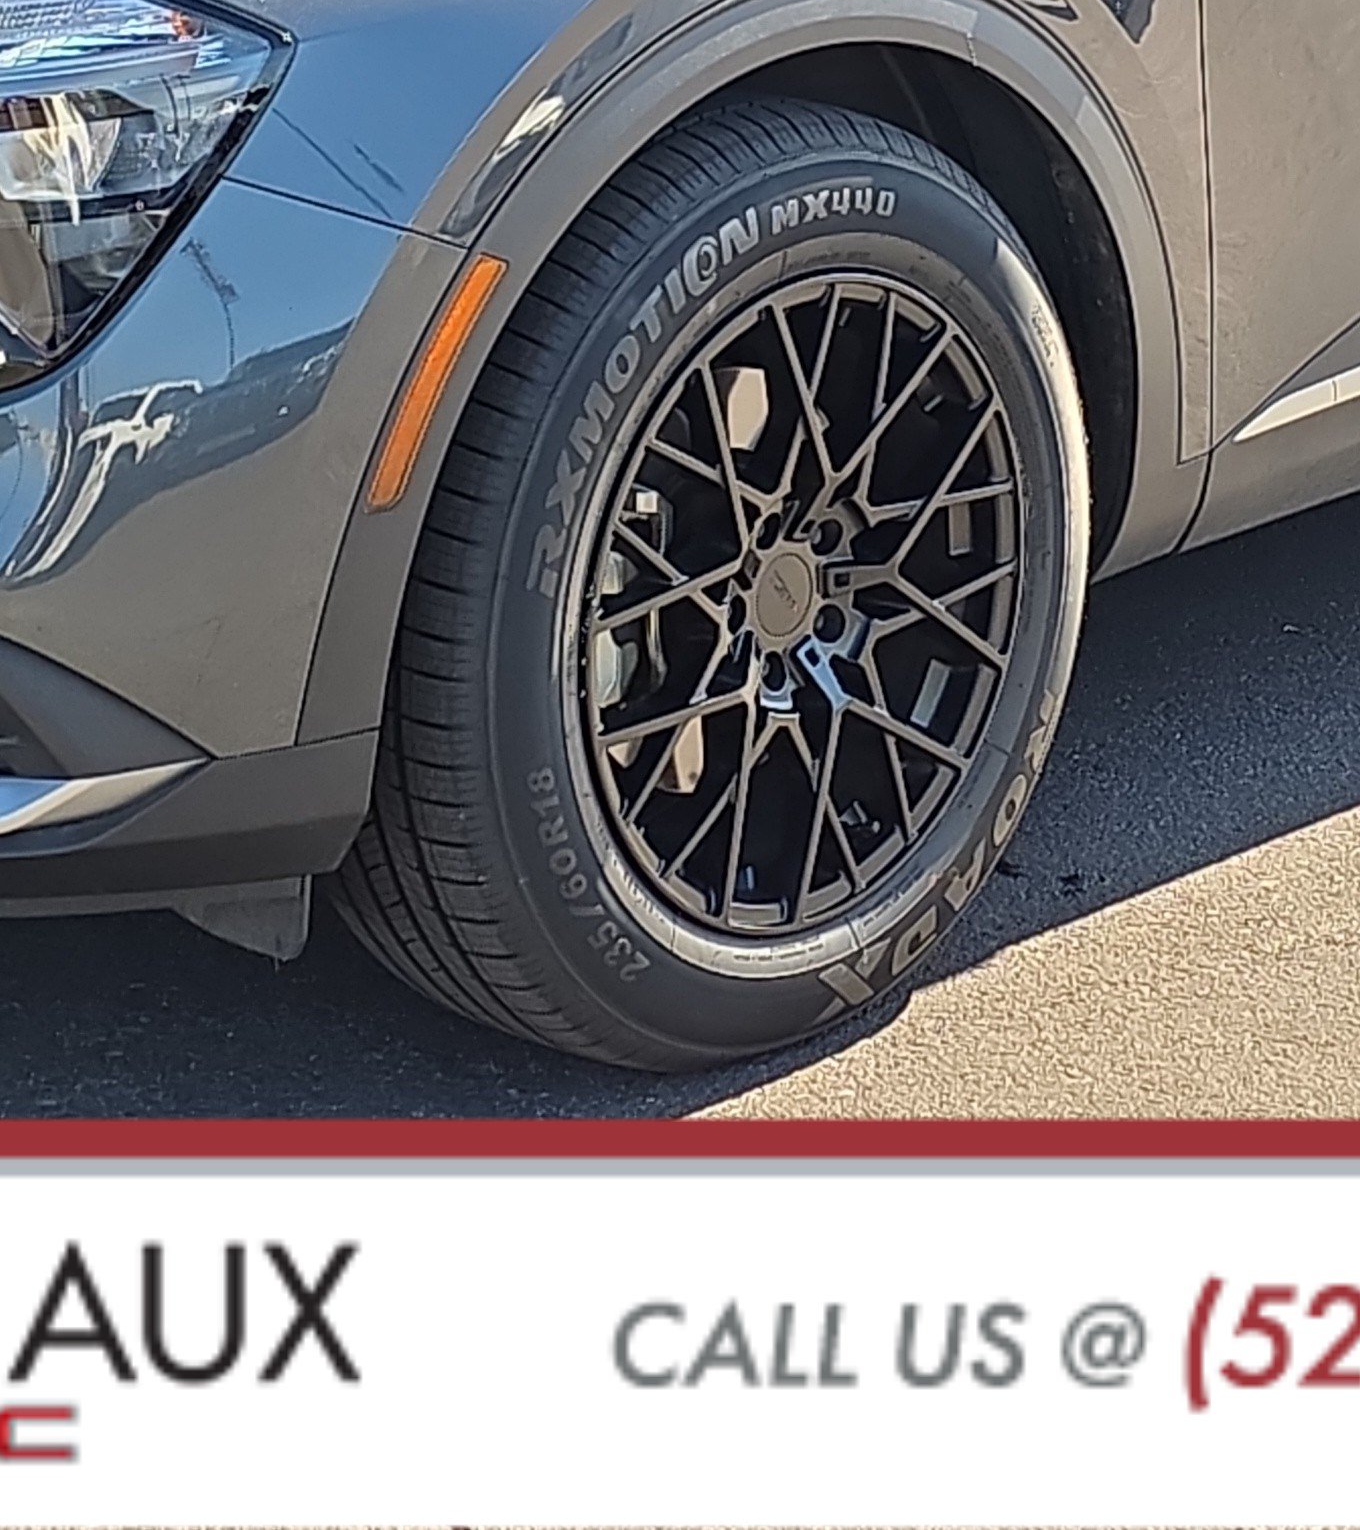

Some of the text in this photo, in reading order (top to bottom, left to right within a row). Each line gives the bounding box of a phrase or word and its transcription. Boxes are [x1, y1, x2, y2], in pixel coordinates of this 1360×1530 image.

[527, 187, 897, 598] RXMOTION MX440
[527, 767, 651, 982] 235/60R18
